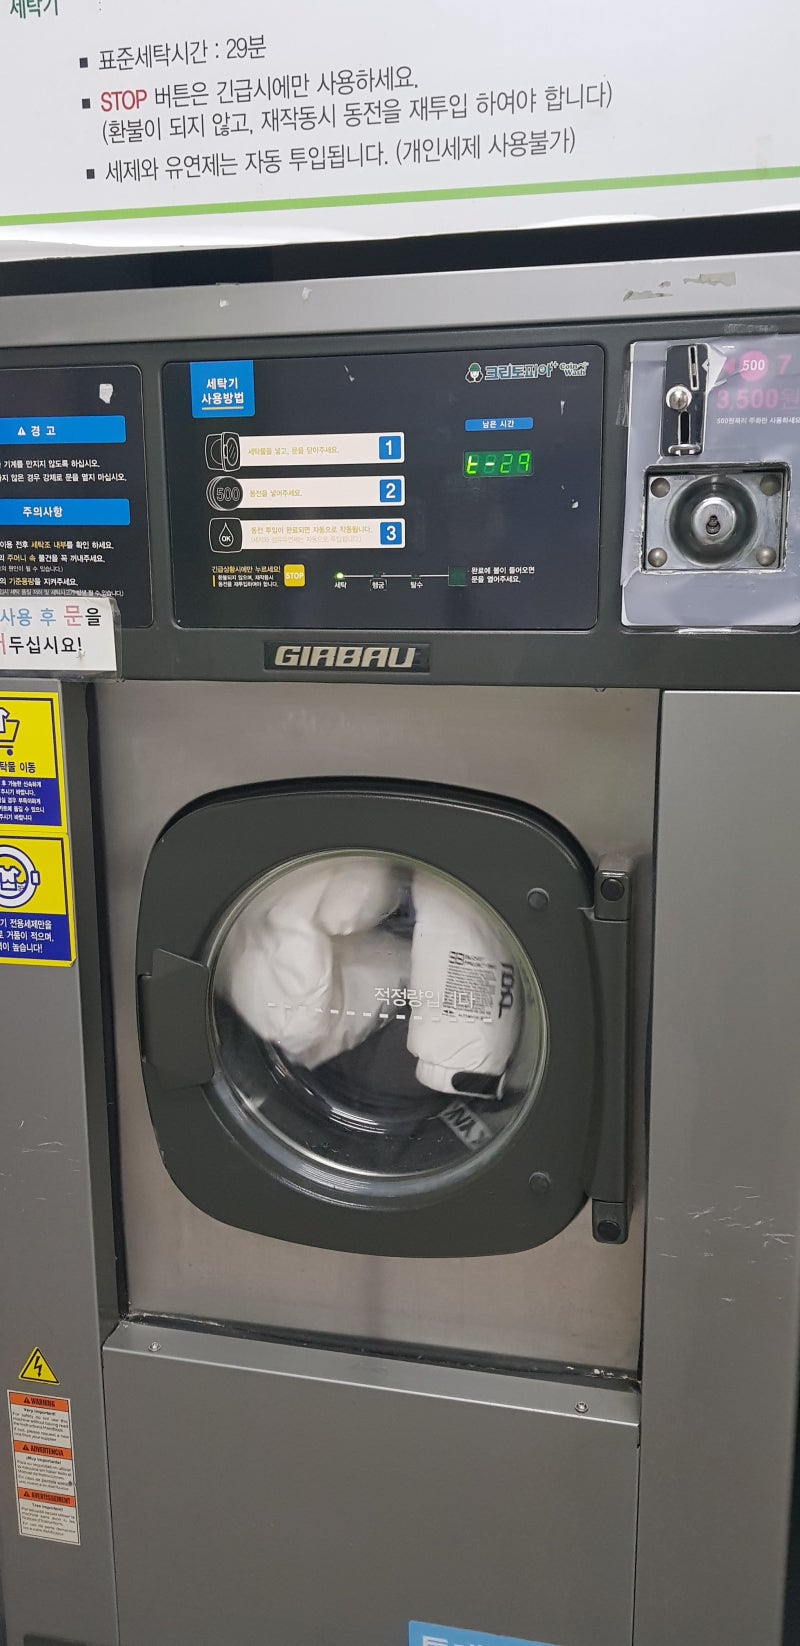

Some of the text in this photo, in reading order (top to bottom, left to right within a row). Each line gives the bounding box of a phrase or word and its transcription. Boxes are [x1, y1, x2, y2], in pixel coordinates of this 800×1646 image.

[99, 40, 208, 71] 표준세탁시간
[226, 34, 266, 60] 29분
[100, 65, 418, 113] STOP 버튼은 긴급시에만 사용하세요.
[102, 80, 612, 146] (환불이 되지 않고, 재작동시 동전을 재투입 하여야 합니다)
[105, 126, 576, 184] 세제와 유연제는 자동 투입됩니다. (개인세제 사용불가)
[742, 359, 766, 371] 500
[206, 378, 239, 390] 세탁기
[201, 392, 245, 405] 사용방법
[483, 420, 515, 429] 남은 시간
[31, 425, 57, 437] 경 고
[385, 439, 394, 456] 1
[216, 487, 241, 501] 500
[386, 483, 396, 499] 2
[23, 506, 63, 518] 주의사항
[221, 535, 232, 543] OK
[386, 525, 397, 541] 3
[410, 581, 424, 589] 탈수
[2, 605, 101, 627] 사용 후 문을
[274, 645, 416, 668] GIRBAU
[20, 762, 36, 774] 이동
[10, 919, 52, 929] 전용세제만을
[7, 931, 28, 941] 거품이
[30, 932, 54, 942] 적으며,
[12, 943, 43, 953] 높습니다!
[31, 1397, 55, 1407] WARNING
[31, 1445, 64, 1456] ADVERTENCIA
[32, 1492, 71, 1504] AVERTISSEMENT
